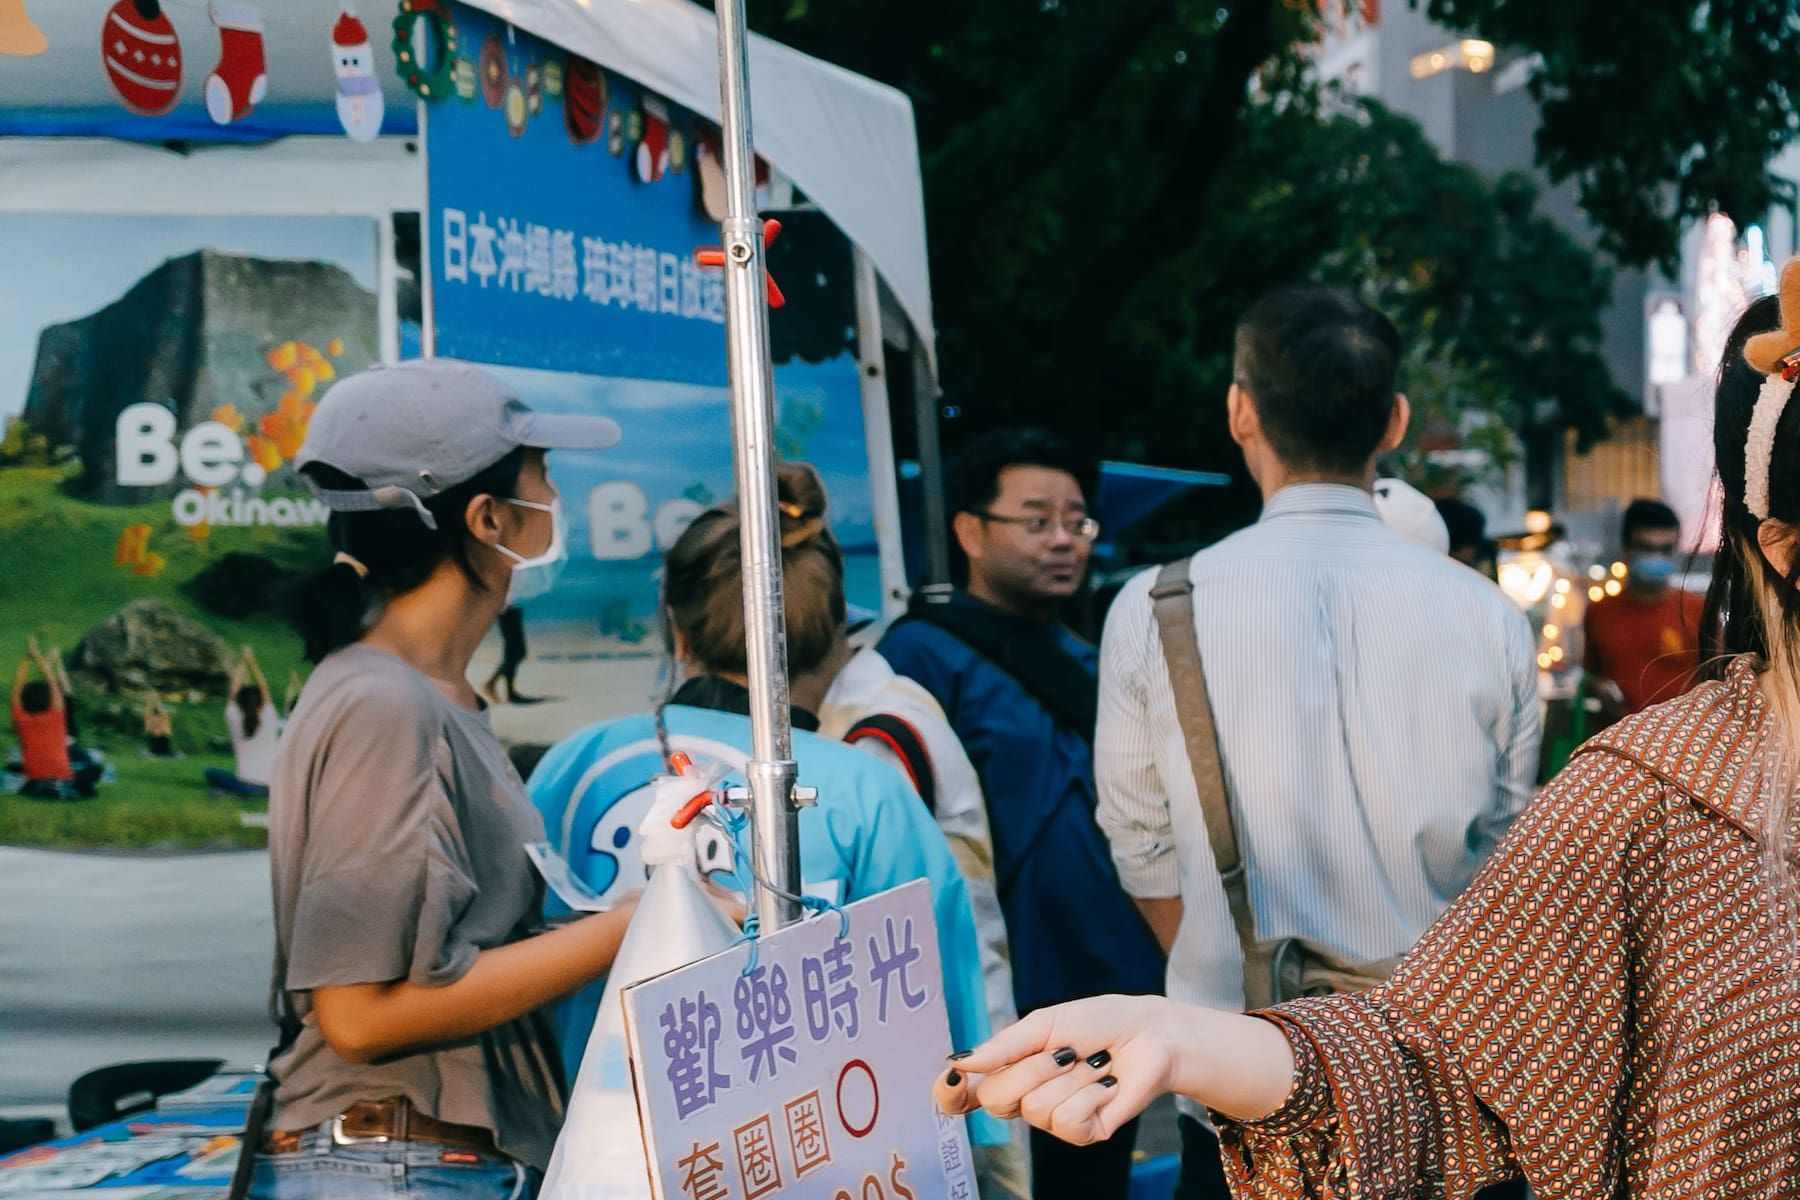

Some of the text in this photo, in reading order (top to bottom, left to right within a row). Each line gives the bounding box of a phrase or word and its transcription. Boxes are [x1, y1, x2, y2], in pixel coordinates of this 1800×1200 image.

[115, 402, 267, 488] Be.
[659, 916, 927, 1121] 歡樂時光
